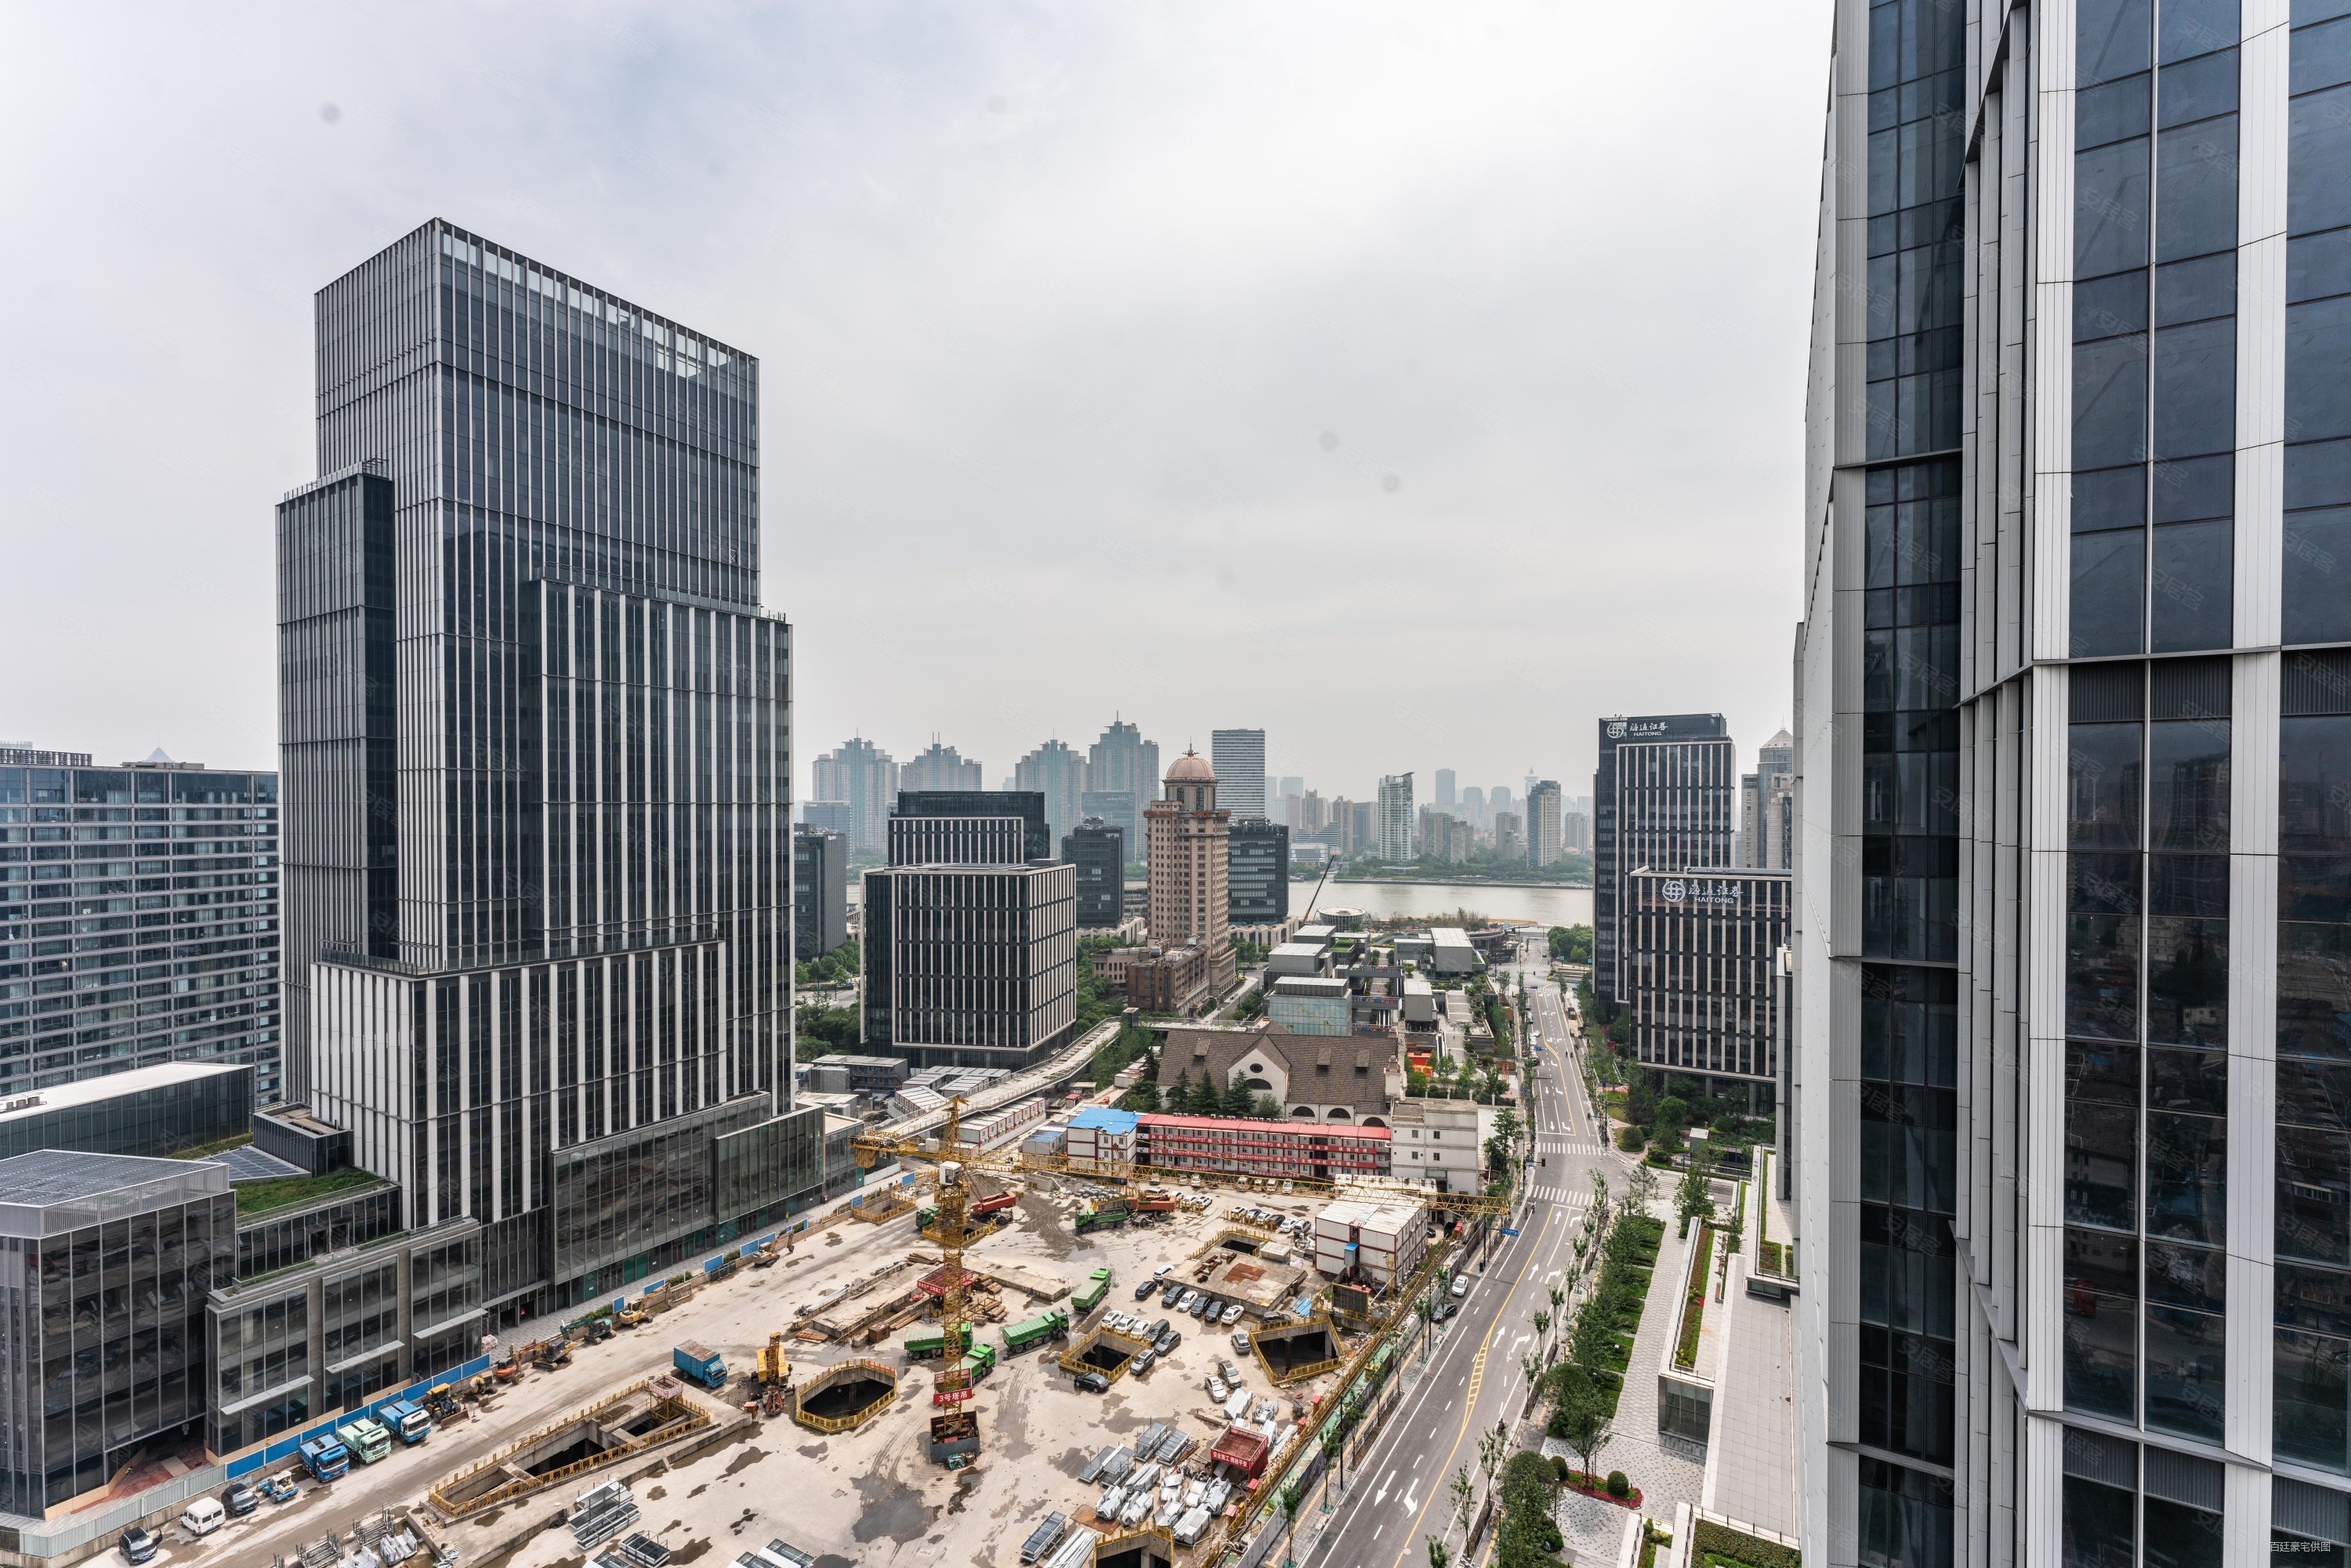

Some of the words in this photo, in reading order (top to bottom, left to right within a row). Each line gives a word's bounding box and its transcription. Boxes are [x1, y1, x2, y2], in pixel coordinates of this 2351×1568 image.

[1630, 721, 1668, 731] 海通证券
[1688, 884, 1744, 897] 海通证券
[850, 1138, 885, 1148] ZOOMLION
[939, 1390, 967, 1402] 3号塔吊
[1212, 1451, 1230, 1461] 安全施工
